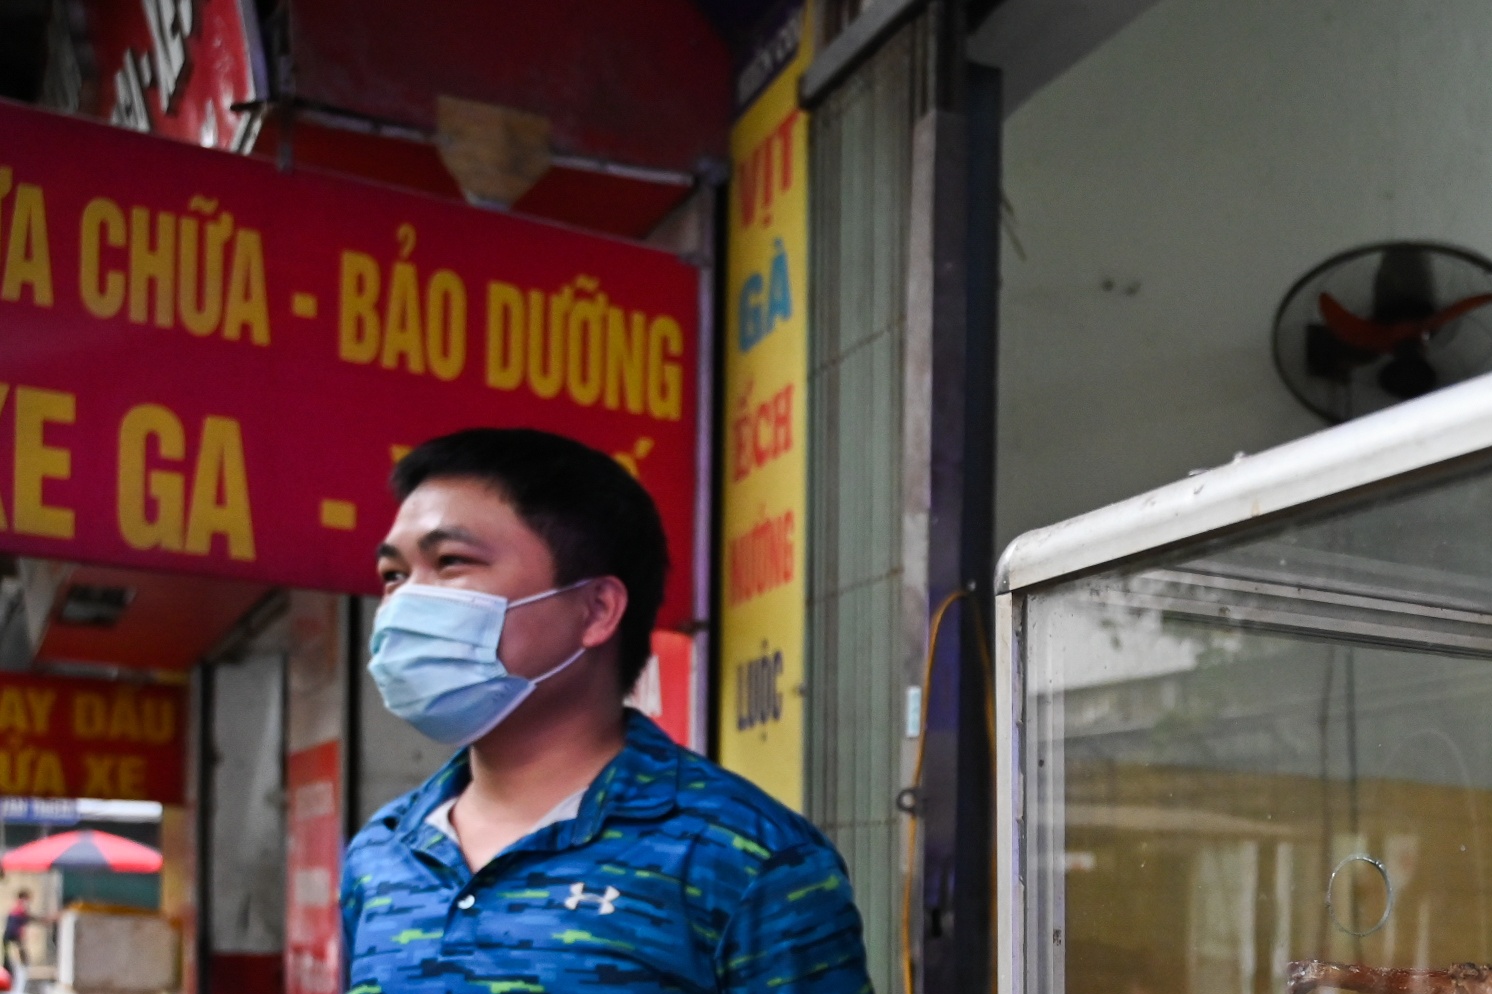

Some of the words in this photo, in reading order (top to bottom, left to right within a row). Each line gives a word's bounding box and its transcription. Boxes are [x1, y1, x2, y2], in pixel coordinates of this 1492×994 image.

[79, 193, 271, 346] CHỮA
[339, 224, 466, 382] BẢO
[487, 273, 683, 422] DƯỠNG
[739, 236, 792, 356] GÀ
[117, 404, 256, 563] GA
[732, 381, 794, 483] ẾCH
[736, 638, 783, 742] LUỘC
[84, 754, 147, 798] XE
